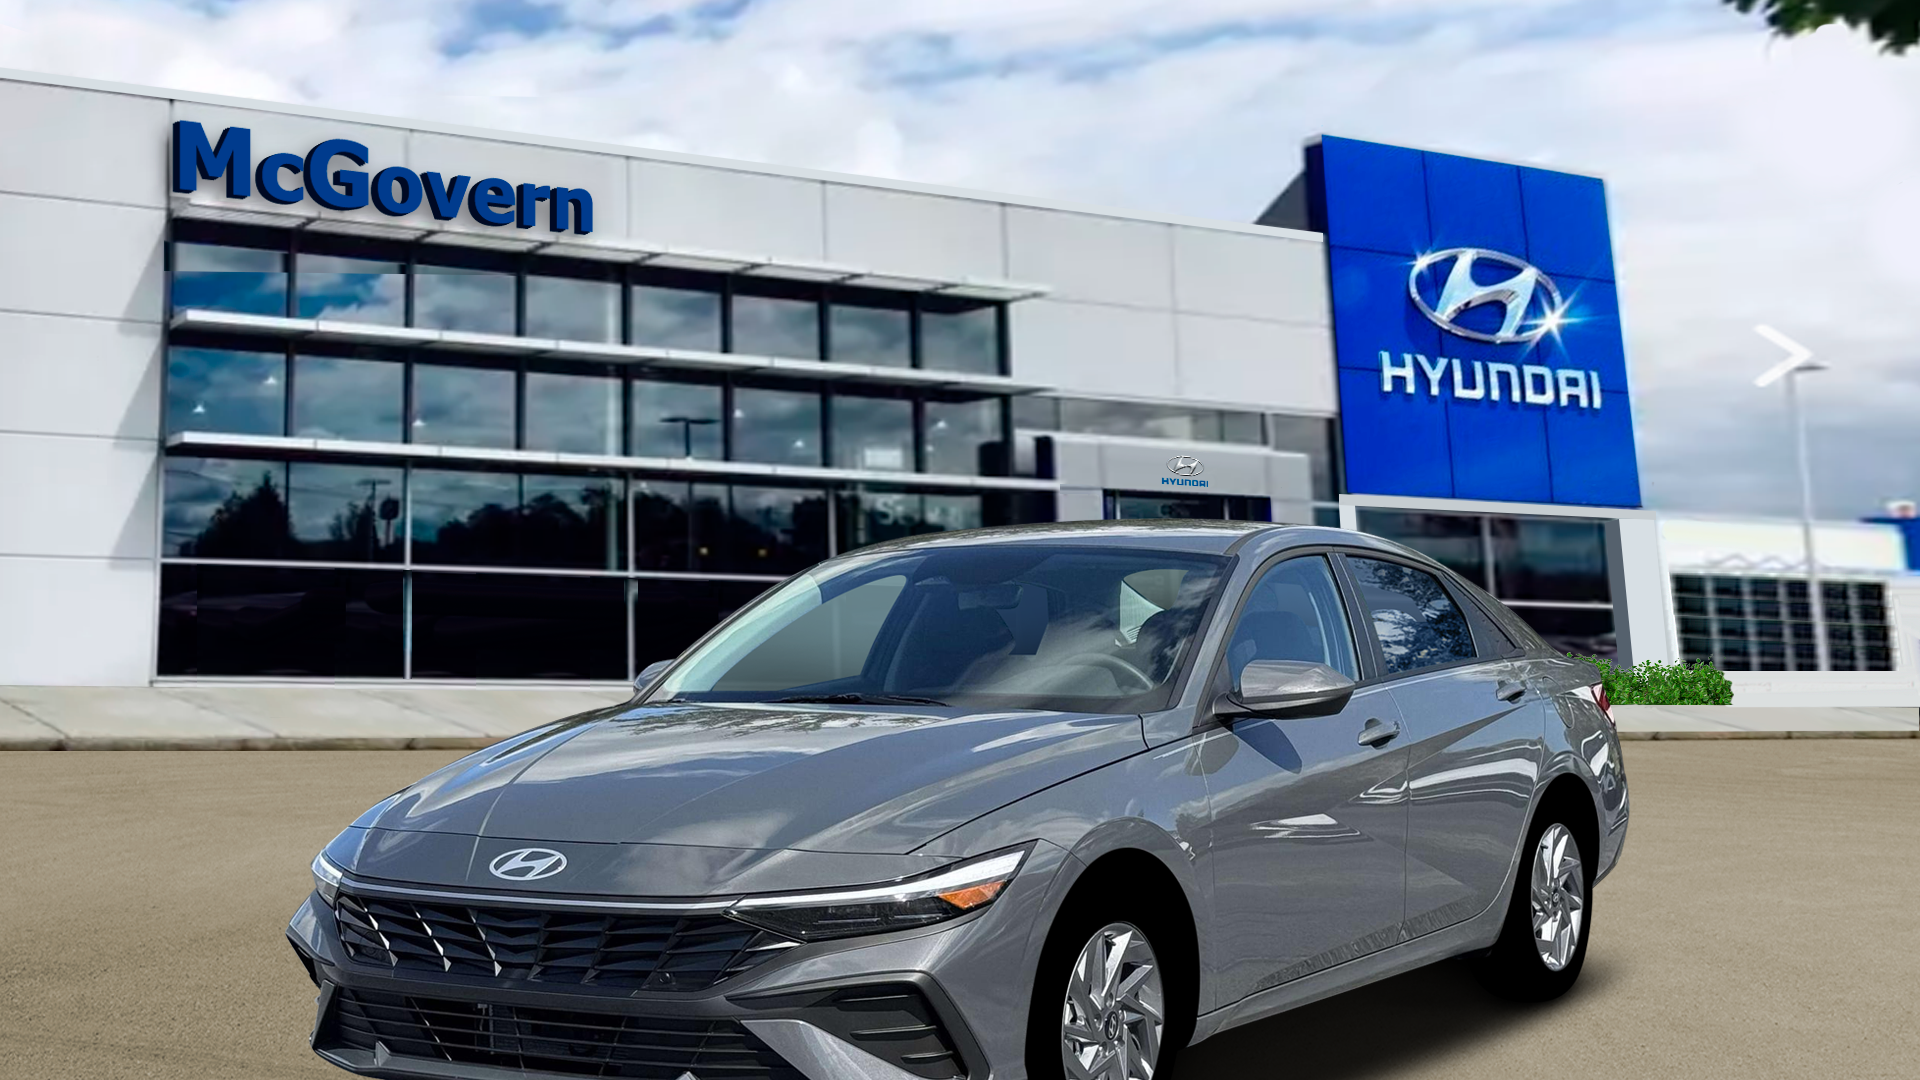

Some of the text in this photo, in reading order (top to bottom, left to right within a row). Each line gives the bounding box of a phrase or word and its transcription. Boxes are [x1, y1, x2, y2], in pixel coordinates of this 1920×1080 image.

[172, 120, 594, 235] McGovern
[1379, 350, 1602, 409] HYUNDAI
[1161, 477, 1209, 488] HYUNDAI
